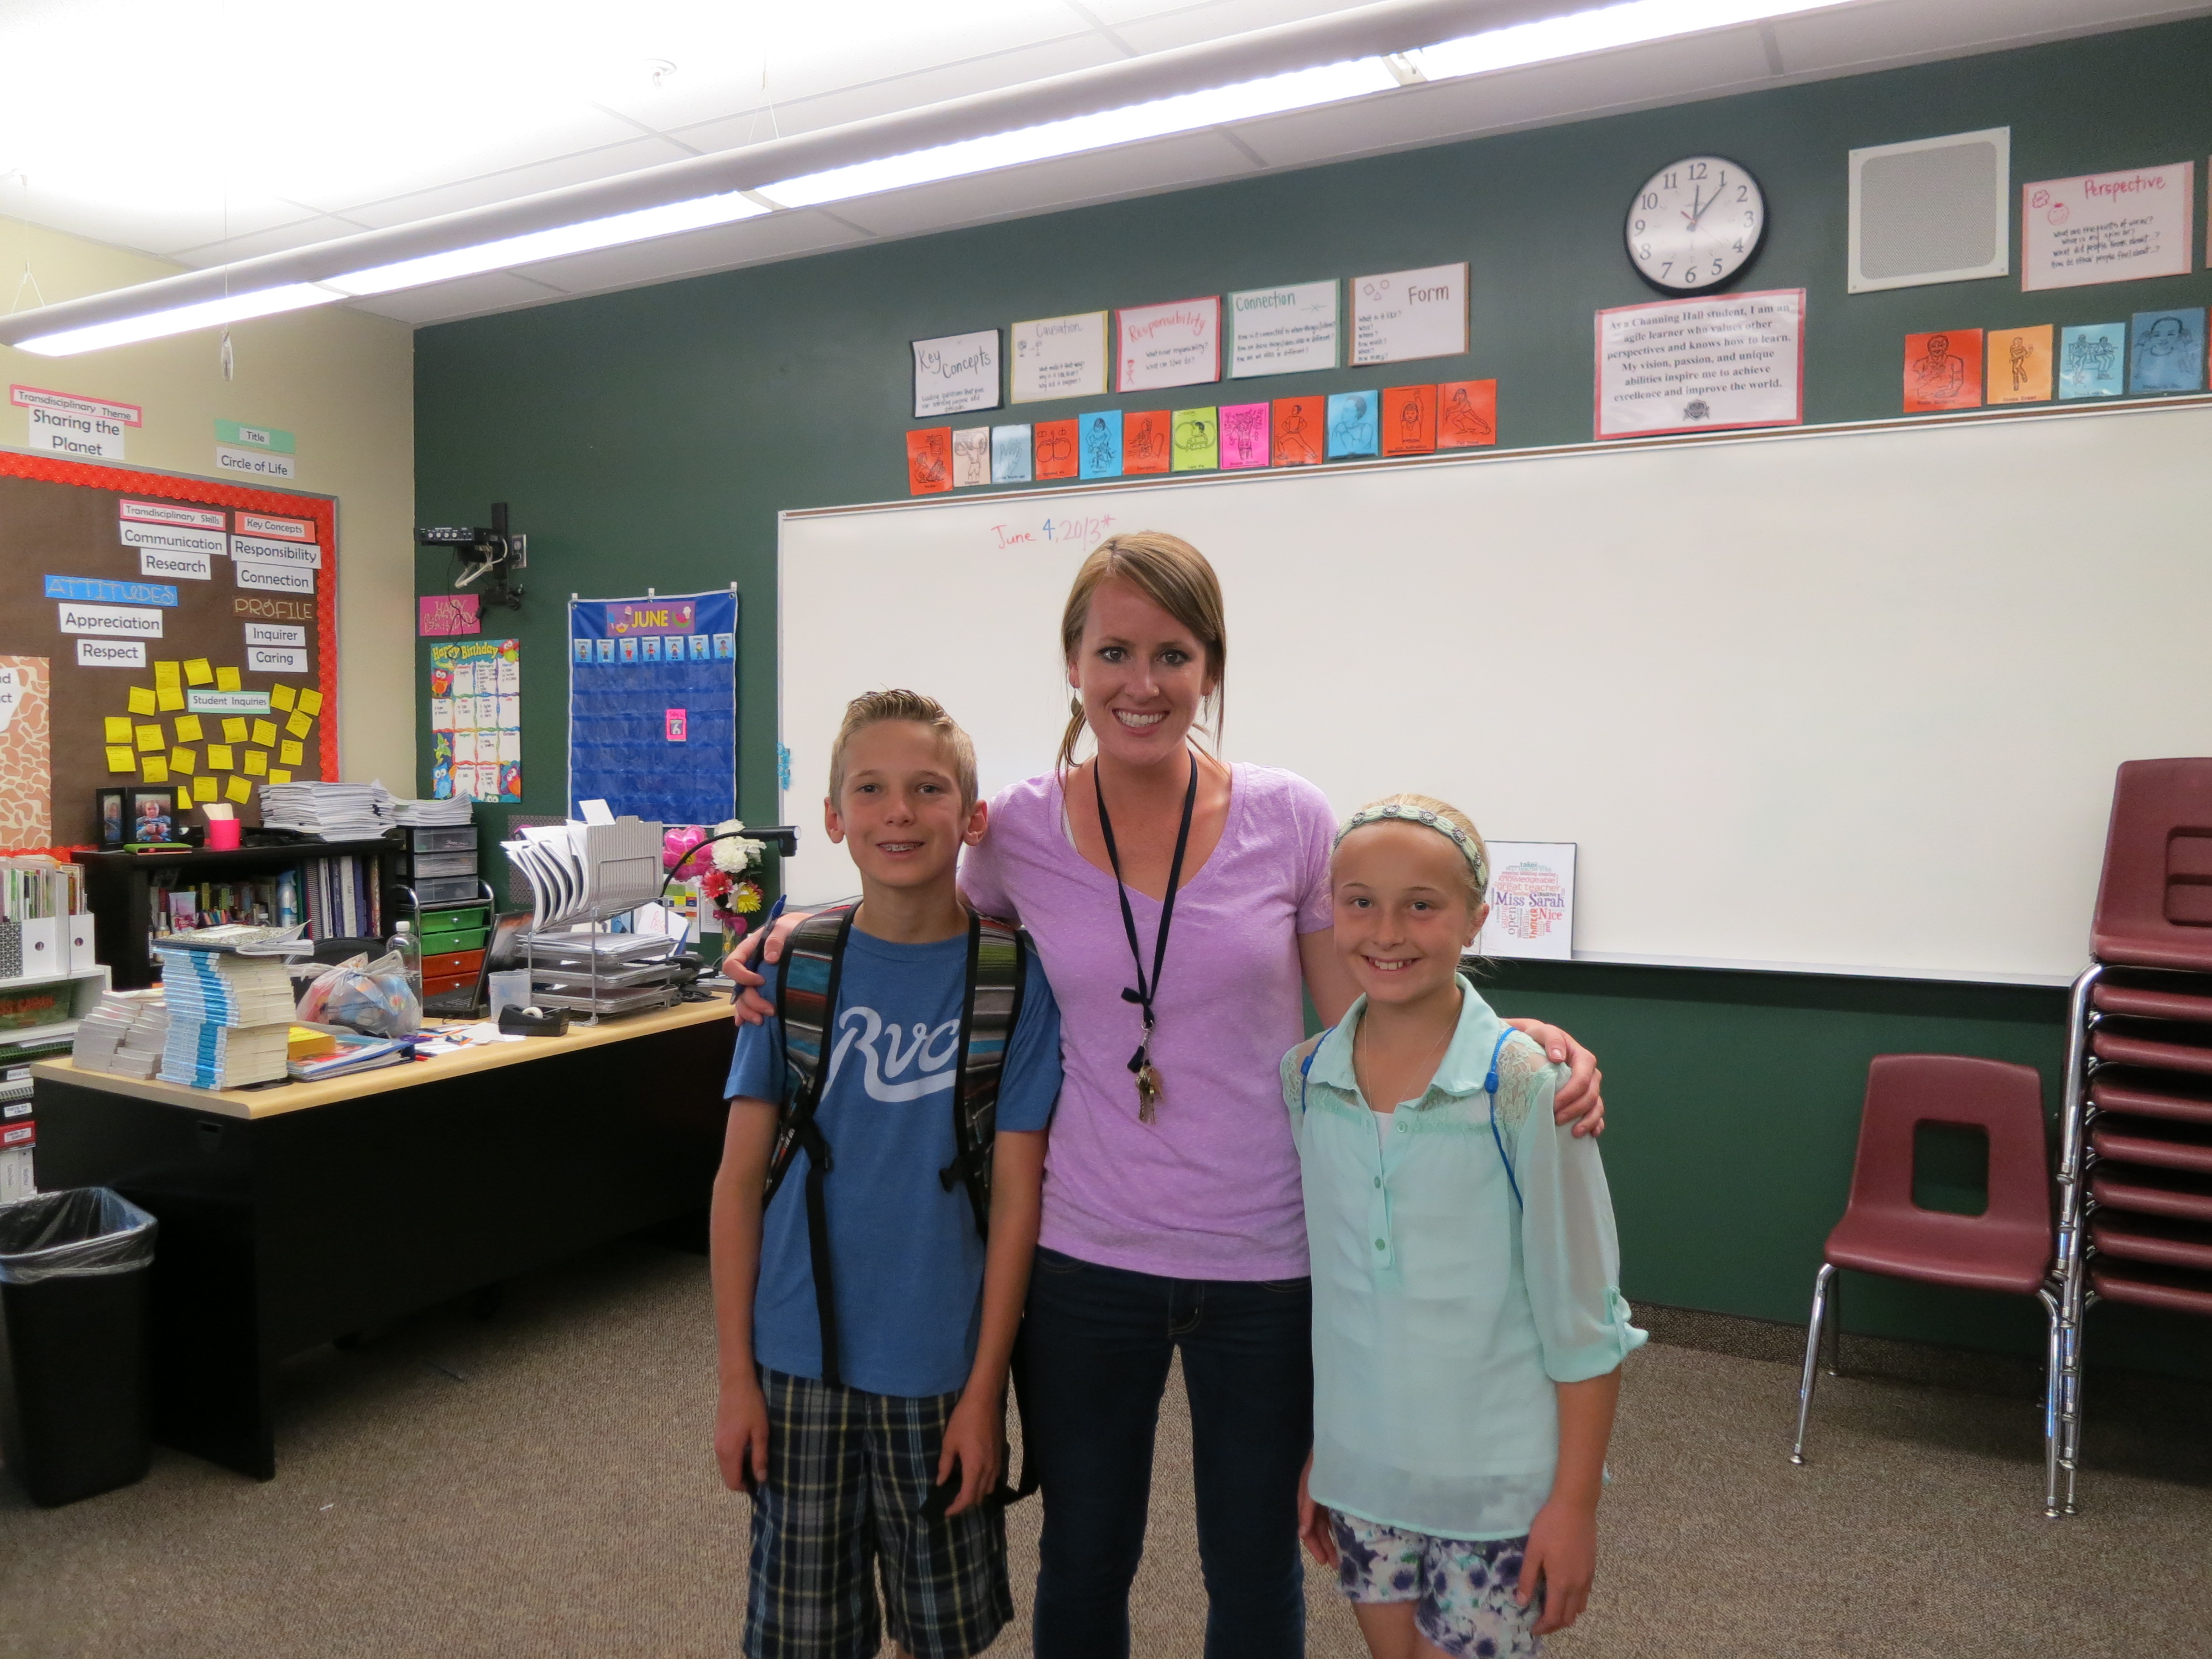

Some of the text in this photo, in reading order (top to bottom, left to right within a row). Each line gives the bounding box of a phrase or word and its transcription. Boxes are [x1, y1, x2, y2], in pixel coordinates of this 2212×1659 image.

[1688, 162, 1708, 181] 12
[1719, 170, 1728, 187] 1
[1663, 173, 1678, 190] 11
[2084, 175, 2166, 203] Perspective
[1641, 192, 1658, 210] 10
[1736, 185, 1749, 203] 2
[1634, 219, 1646, 237] 9
[1743, 210, 1754, 228] 3
[1639, 243, 1652, 260] 8
[1731, 237, 1745, 254] 4
[1661, 262, 1673, 279] 7
[1684, 265, 1698, 284] 6
[1710, 258, 1723, 276] 5
[1236, 290, 1296, 312] Connection
[1408, 285, 1449, 306] Form
[1128, 310, 1206, 343] Responsibility
[1610, 321, 1621, 330] As
[1632, 314, 1679, 327] Channing
[1683, 310, 1704, 321] Hall
[1707, 308, 1747, 318] student,
[1750, 305, 1755, 314] I
[1036, 320, 1083, 338] Causation
[1624, 320, 1773, 343] agile learner who values other
[1607, 334, 1791, 361] perspectives and knows how to learn.
[918, 349, 941, 374] Key
[942, 345, 992, 379] Concepts
[1622, 350, 1775, 373] My vision, passion, and unique
[1625, 375, 1662, 386] abilities
[1665, 372, 1699, 383] inspire
[1720, 369, 1730, 377] to
[1733, 365, 1771, 375] achieve
[1614, 378, 1782, 402] excellence and improve the world.
[19, 390, 131, 420] Transdisciplinary Theme
[33, 409, 120, 436] Sharing the
[52, 435, 102, 456] Planet
[246, 431, 265, 442] Title
[221, 455, 288, 476] Circle of Life
[126, 505, 220, 525] Transdisciplinary Skills
[247, 518, 302, 534] Key Concepts
[124, 529, 222, 551] Communication
[990, 524, 1036, 550] June
[235, 540, 317, 564] Responsibility
[146, 555, 206, 573] Research
[241, 569, 309, 588] Connection
[48, 577, 175, 605] ATTITUDES
[234, 597, 313, 619] PROFILE
[65, 612, 160, 632] Appreciation
[631, 609, 669, 628] JUNE
[253, 628, 298, 645] Inquirer
[83, 643, 139, 661] Respect
[255, 651, 294, 666] Caring
[432, 641, 498, 661] Happy Birthday
[0, 672, 11, 684] d
[193, 695, 267, 706] Student Inquiries
[672, 723, 681, 734] 6
[1497, 883, 1561, 892] great teacher
[1498, 875, 1556, 884] knowledgeable
[1495, 891, 1565, 907] Miss Sarah
[1501, 905, 1509, 929] caring
[1507, 906, 1519, 935] open
[1538, 909, 1563, 920] Nice
